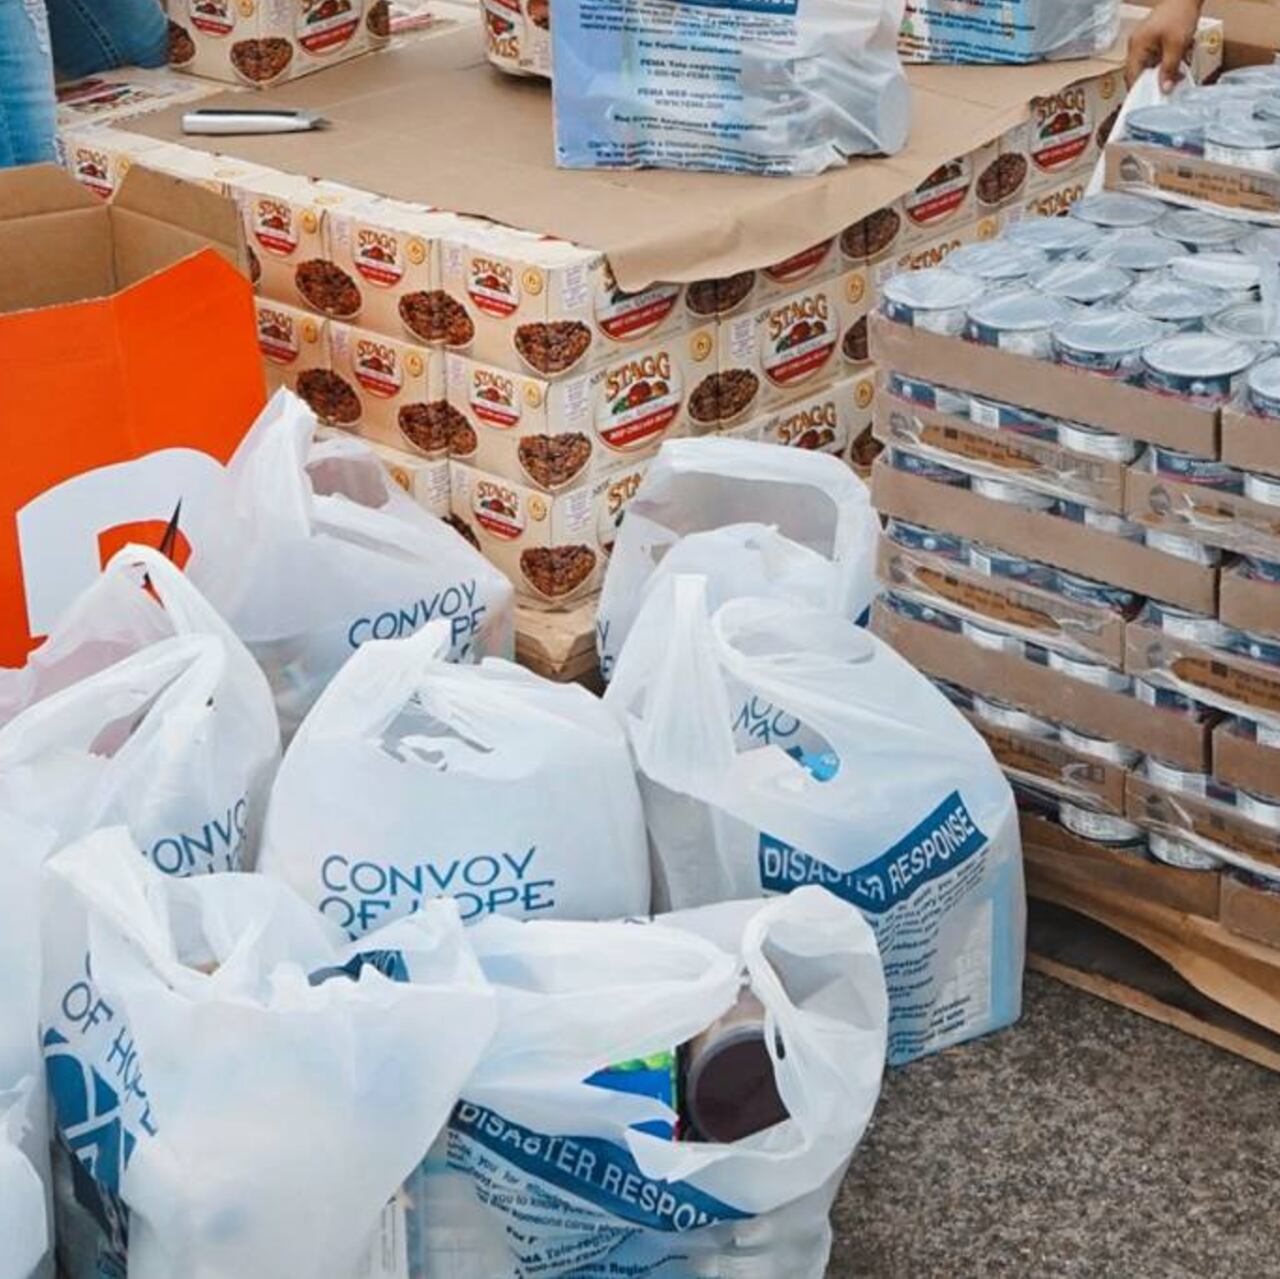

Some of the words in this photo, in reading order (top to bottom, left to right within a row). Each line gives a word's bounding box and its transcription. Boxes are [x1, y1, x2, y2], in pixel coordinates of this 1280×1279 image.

[357, 229, 397, 255] STAGG
[472, 257, 513, 285] STAGG
[769, 293, 828, 340] STAGG
[357, 339, 397, 365] STAGG
[474, 370, 514, 395] STAGG
[606, 351, 670, 403] STAGG
[777, 401, 837, 445] STAGG
[478, 481, 518, 506] STAGG
[608, 472, 642, 516] STA
[349, 579, 476, 649] CONVOY
[321, 846, 536, 896] CONVOY
[888, 806, 976, 896] RESPONSE
[320, 896, 391, 931] OF
[409, 879, 555, 921] OPE
[62, 982, 114, 1035] OF
[458, 1103, 597, 1182] DISASTER
[601, 1163, 719, 1233] RESPO
